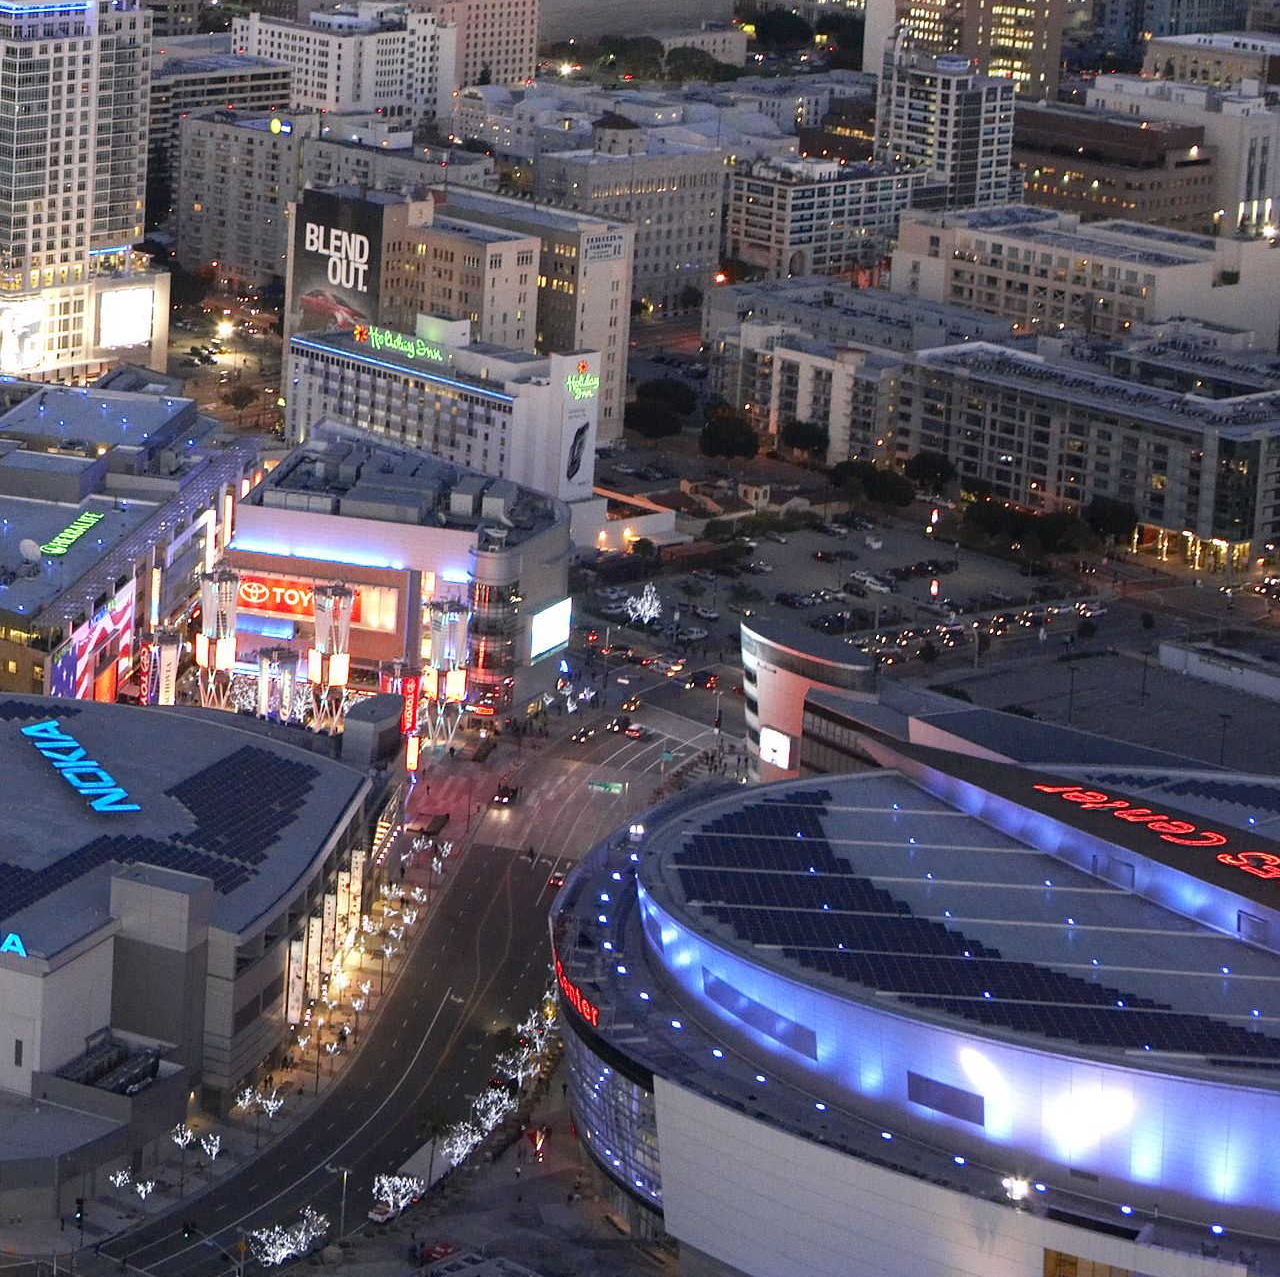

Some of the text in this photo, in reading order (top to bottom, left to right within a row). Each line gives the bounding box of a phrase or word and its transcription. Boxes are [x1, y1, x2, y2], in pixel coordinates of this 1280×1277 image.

[305, 222, 370, 264] BLEND
[327, 256, 369, 293] OUT.
[368, 325, 443, 361] Holiday Inn
[565, 373, 600, 392] Holiday
[574, 388, 594, 400] Inn
[48, 511, 105, 548] HERBALIFE
[272, 587, 316, 608] TOY
[140, 674, 149, 705] TOY
[20, 720, 142, 813] NOKIA
